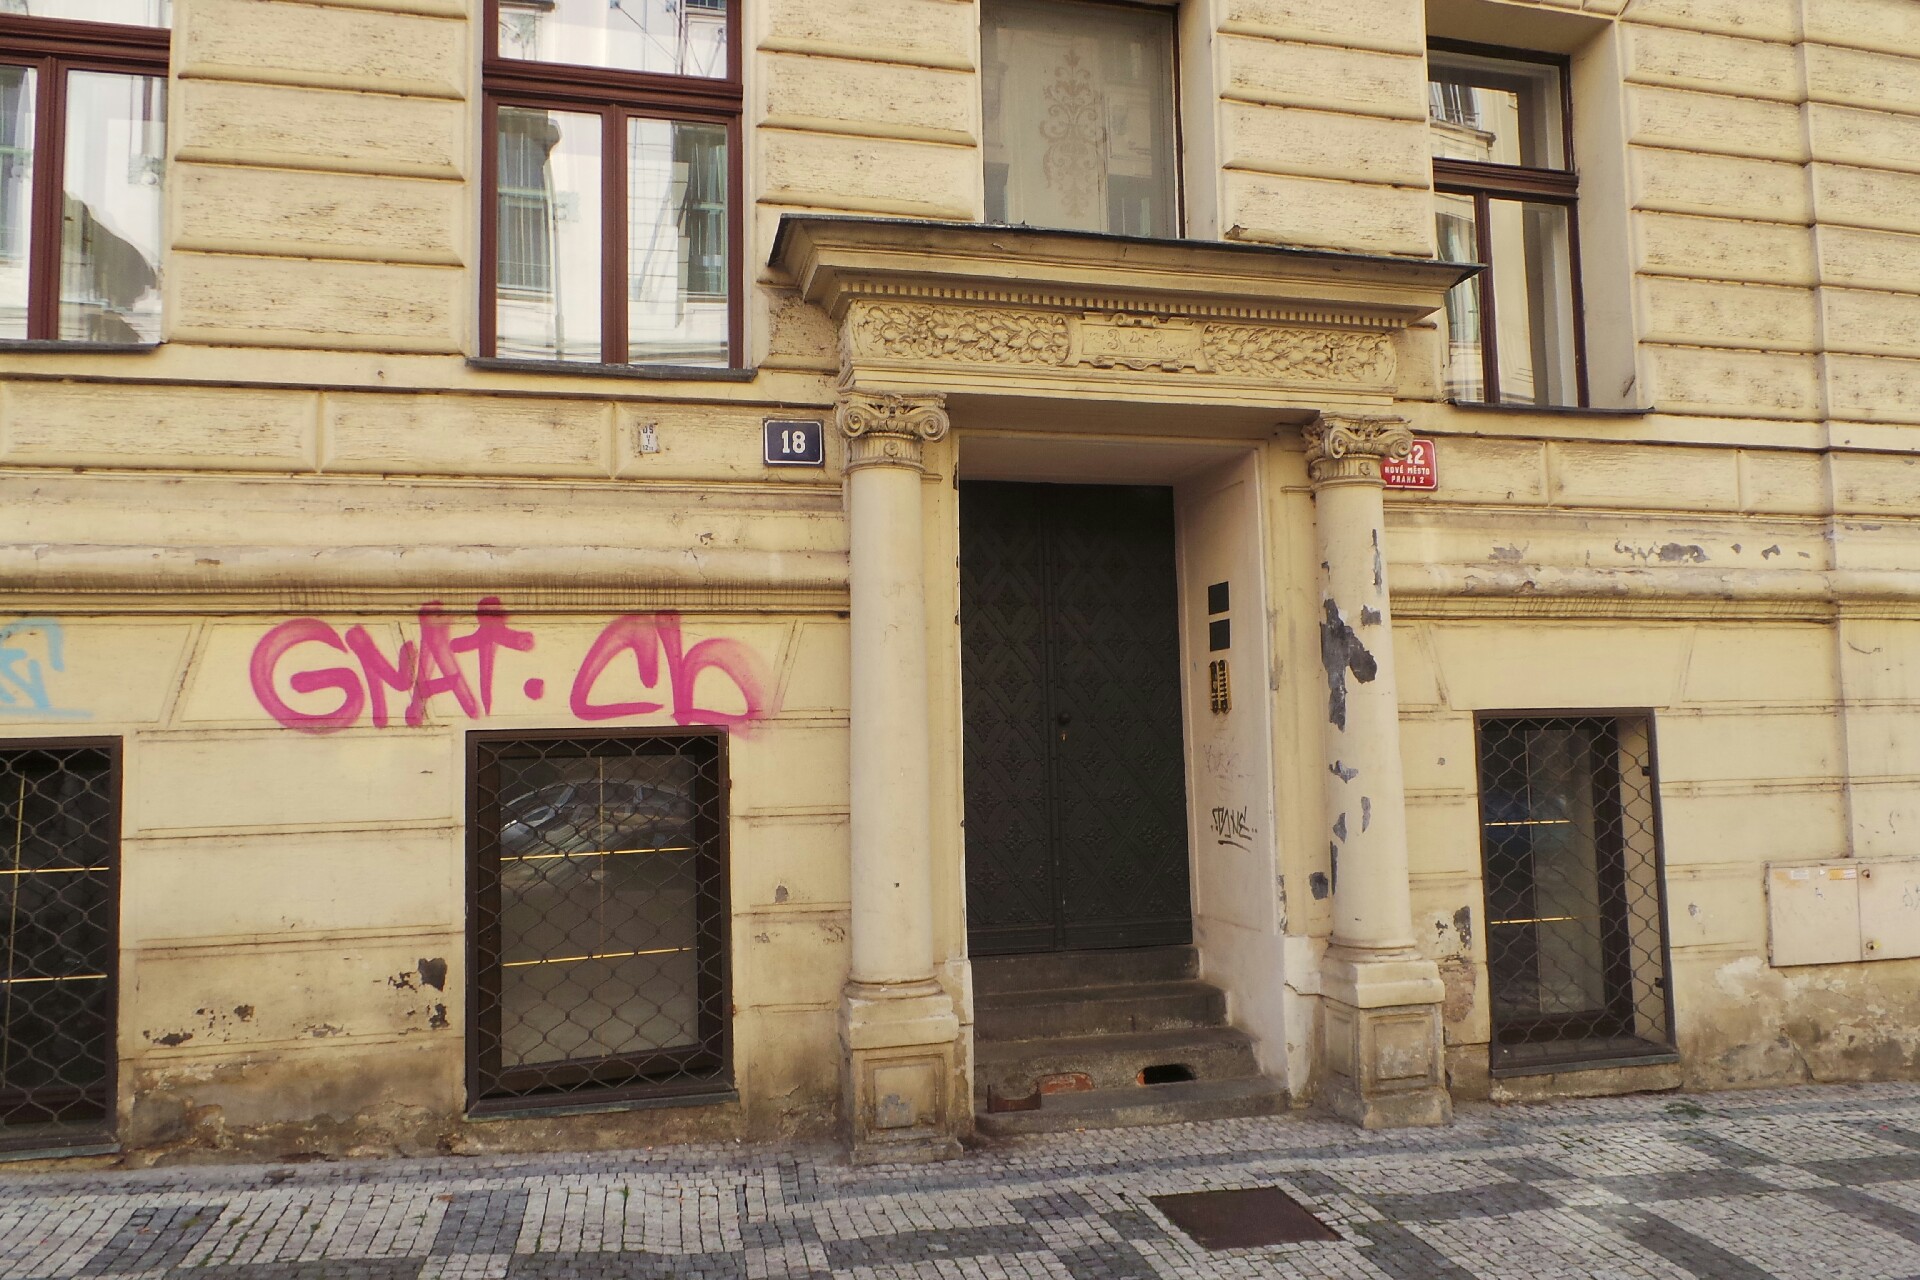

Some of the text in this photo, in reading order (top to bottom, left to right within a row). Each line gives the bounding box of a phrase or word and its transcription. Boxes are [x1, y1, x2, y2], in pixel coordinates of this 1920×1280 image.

[781, 430, 806, 454] 18
[1384, 465, 1430, 475] NOVÉ MĚSTO
[1391, 475, 1425, 484] PRAHA 2
